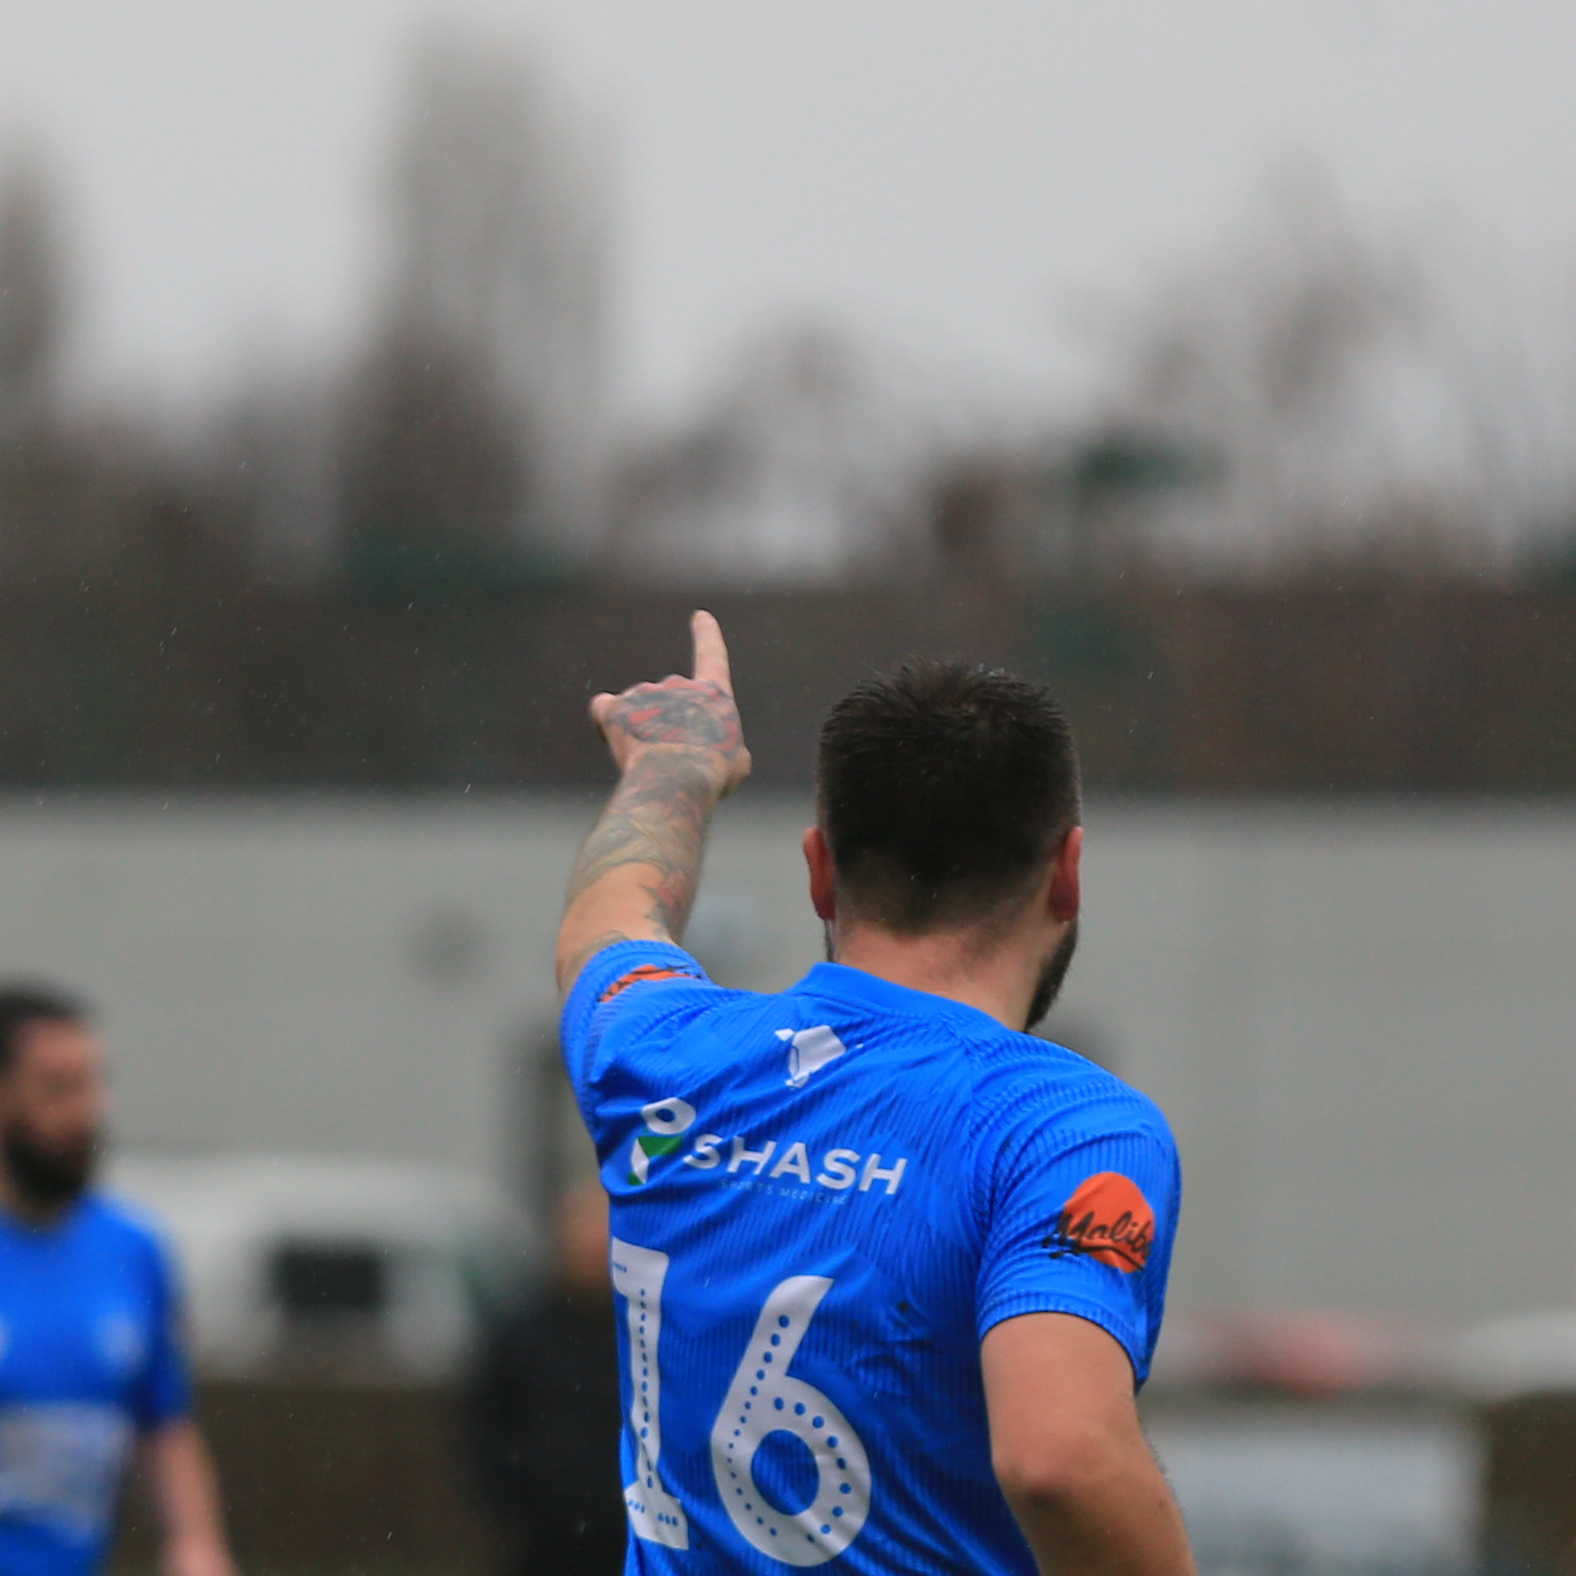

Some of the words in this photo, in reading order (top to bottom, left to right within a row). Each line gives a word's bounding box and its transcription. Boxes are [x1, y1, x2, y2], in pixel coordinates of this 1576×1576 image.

[683, 1133, 909, 1196] SHASH
[1042, 1210, 1152, 1260] Malib
[611, 1236, 872, 1567] 16
